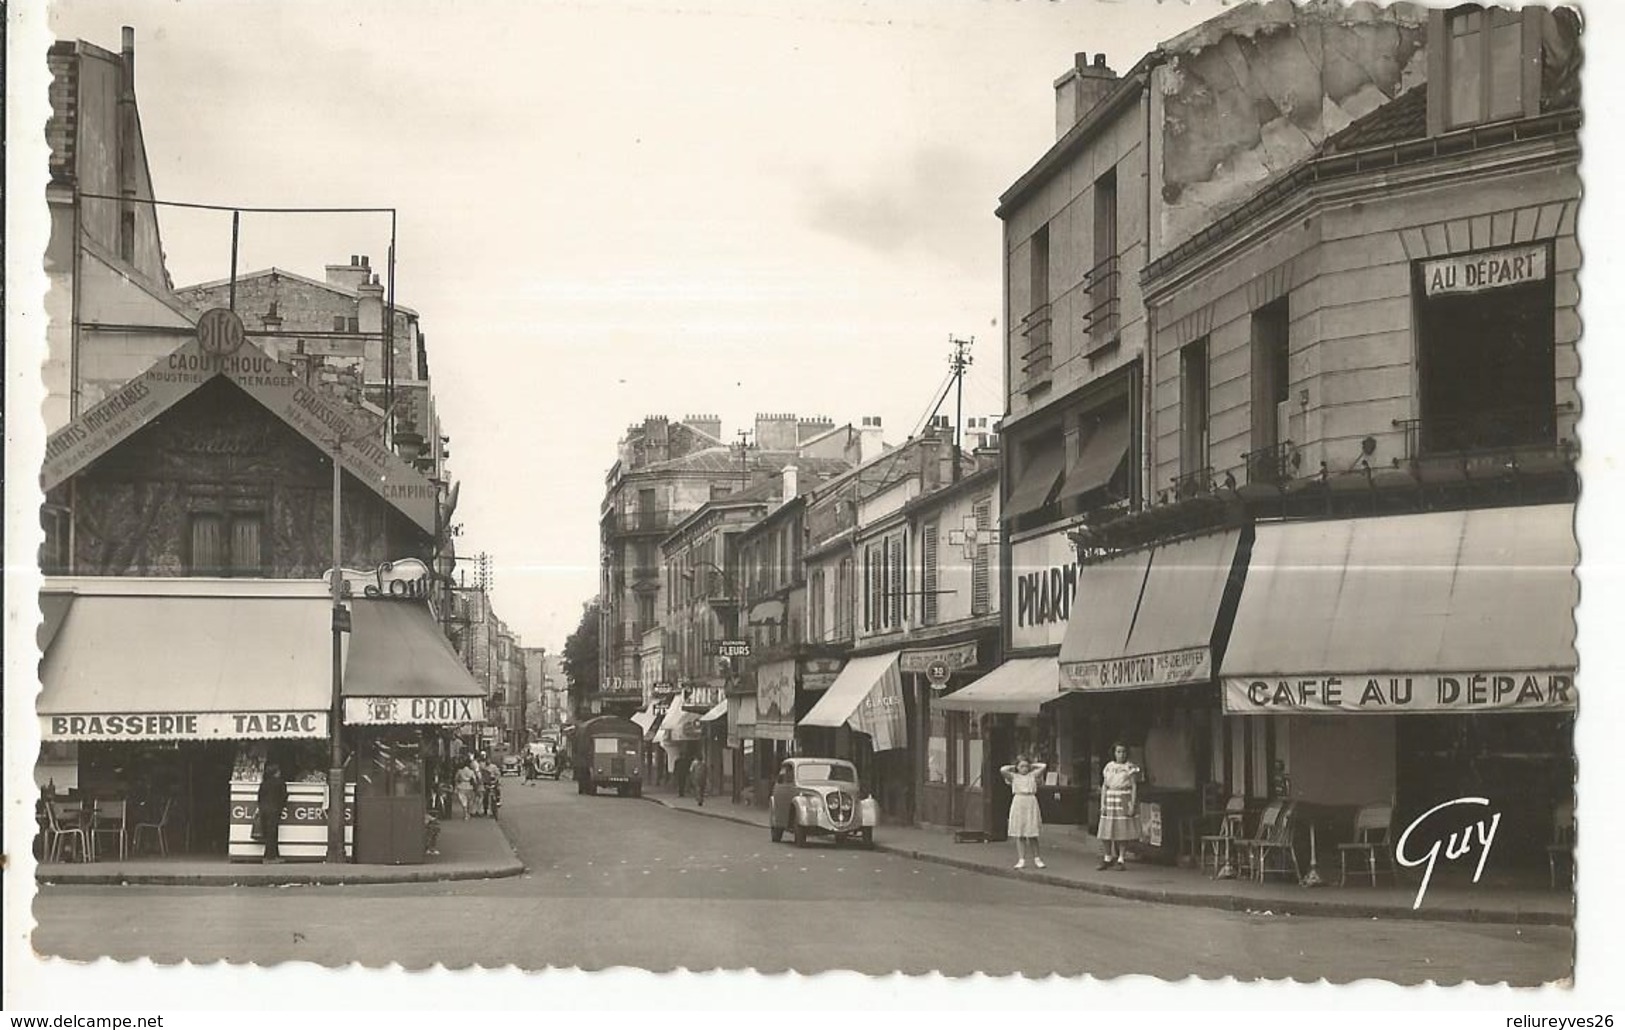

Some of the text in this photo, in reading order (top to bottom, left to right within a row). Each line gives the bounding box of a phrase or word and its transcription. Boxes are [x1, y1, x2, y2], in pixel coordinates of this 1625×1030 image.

[1432, 252, 1537, 290] AU DÉPART
[168, 353, 272, 374] CAOUTCHOUC
[146, 371, 205, 383] INDUSTRIEL
[43, 423, 87, 464] TEMENTS
[383, 485, 434, 499] CAMPING
[1018, 562, 1082, 628] PHARM
[719, 646, 750, 656] FLEURS
[1247, 674, 1574, 706] CAFÉ AU DÉPAR
[411, 698, 472, 720] CROIX
[51, 713, 318, 735] BRASSERIE TABAC
